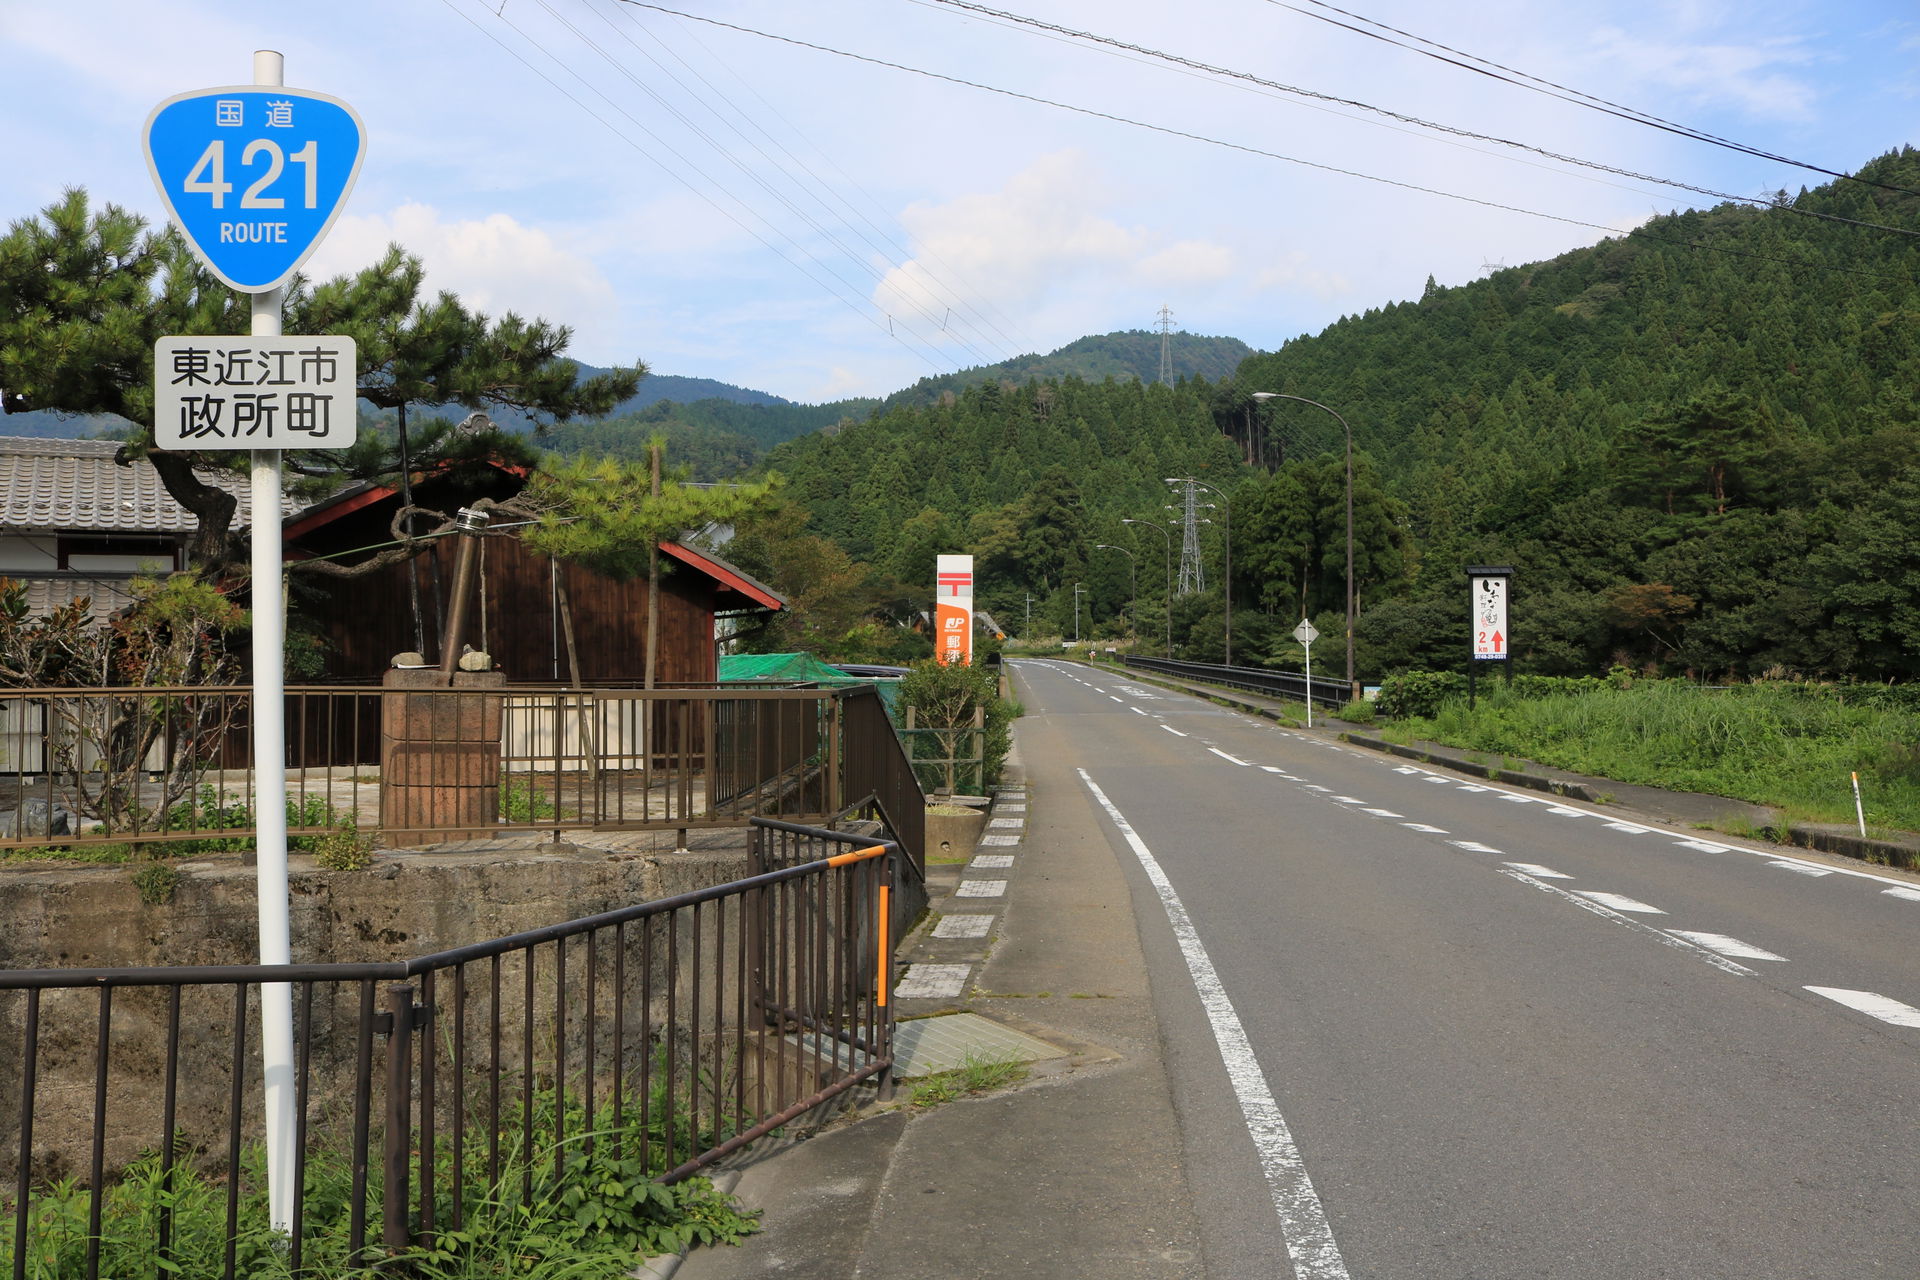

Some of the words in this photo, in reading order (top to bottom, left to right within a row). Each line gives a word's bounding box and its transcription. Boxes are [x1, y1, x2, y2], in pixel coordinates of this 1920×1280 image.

[216, 100, 295, 128] 国道
[183, 138, 318, 209] 421
[220, 222, 288, 244] ROUTE
[171, 346, 339, 387] 東近江市
[178, 392, 334, 439] 政所町
[1479, 631, 1486, 643] 2
